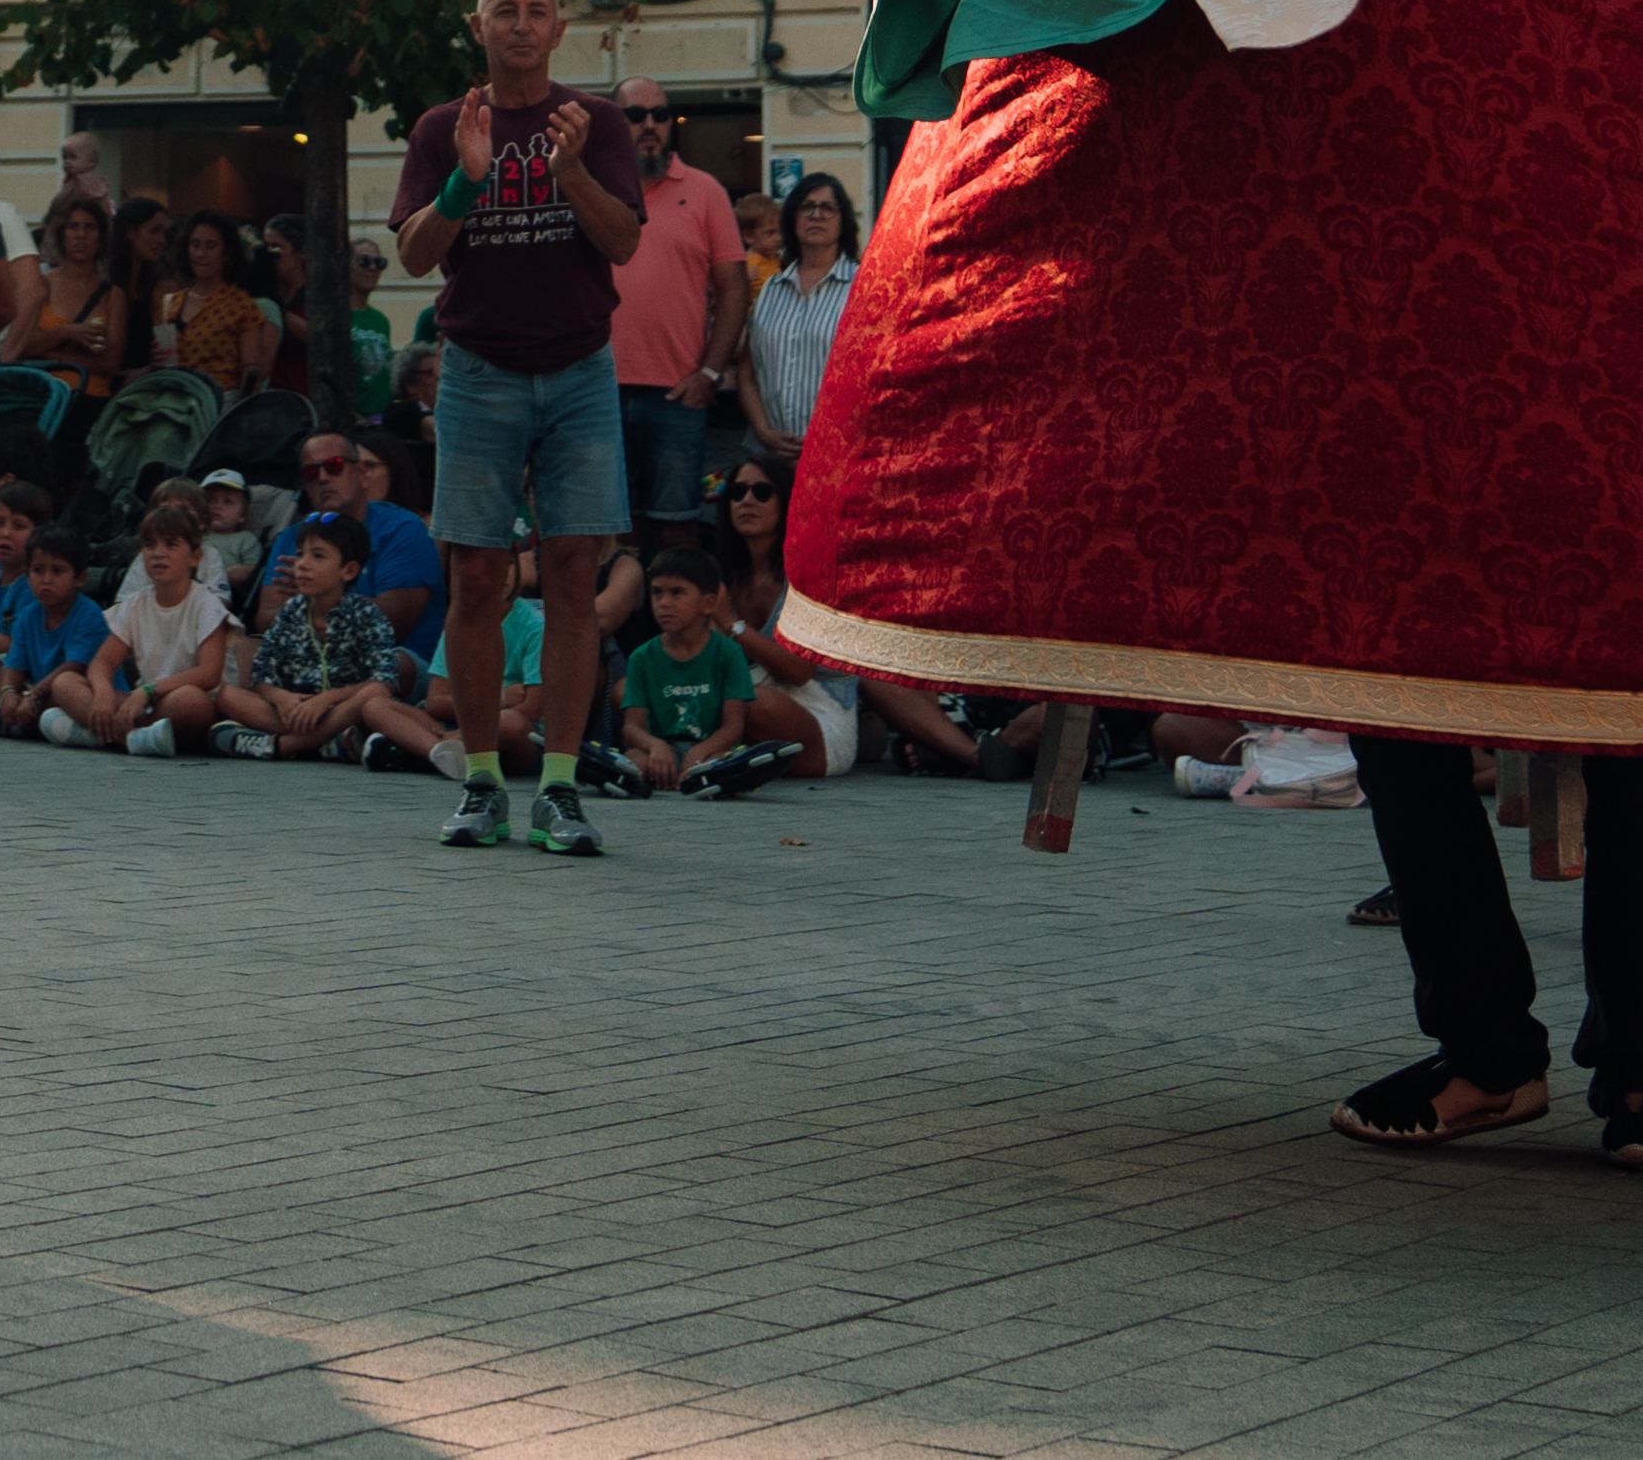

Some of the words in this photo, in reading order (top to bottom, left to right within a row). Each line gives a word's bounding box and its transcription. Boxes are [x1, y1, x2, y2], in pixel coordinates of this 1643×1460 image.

[481, 214, 503, 227] QUE
[505, 212, 530, 227] UNA
[532, 208, 576, 226] AMISTA
